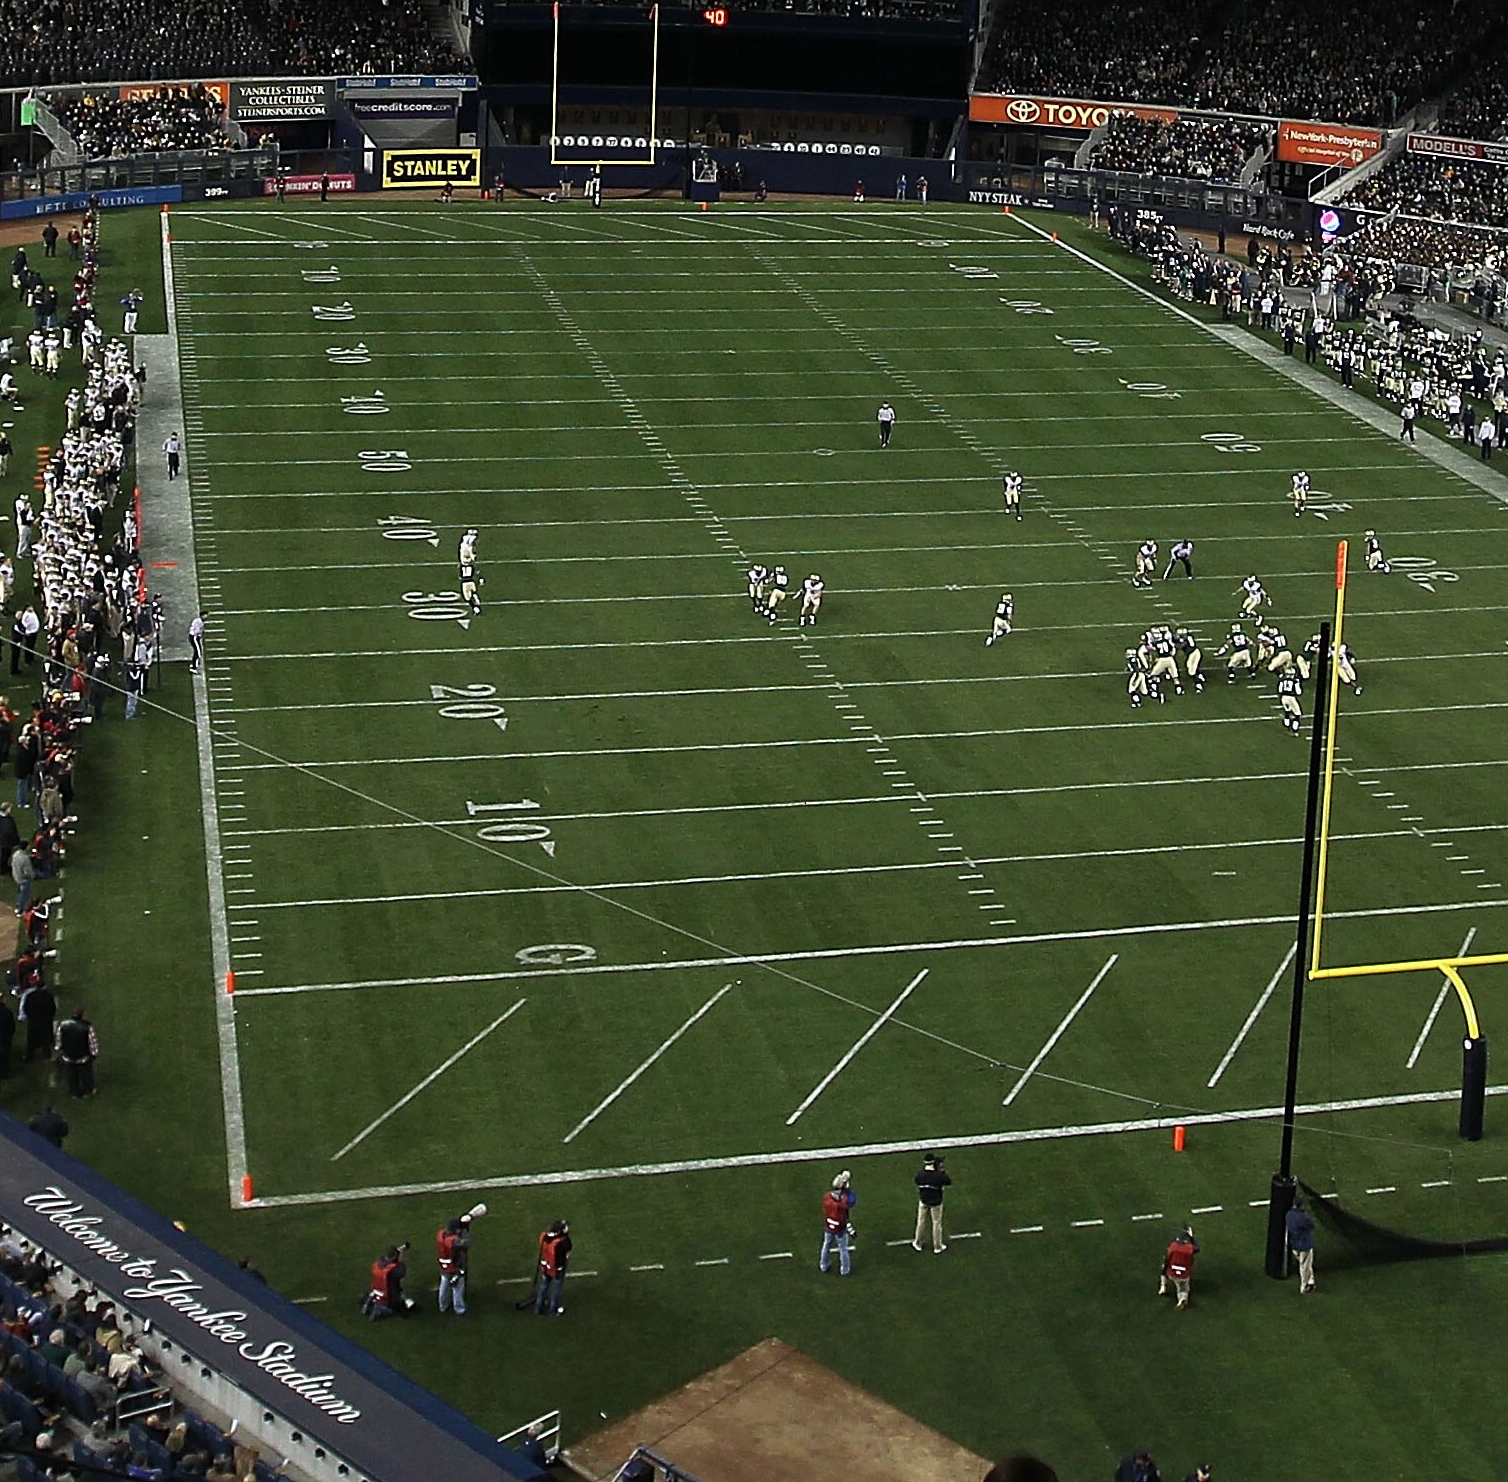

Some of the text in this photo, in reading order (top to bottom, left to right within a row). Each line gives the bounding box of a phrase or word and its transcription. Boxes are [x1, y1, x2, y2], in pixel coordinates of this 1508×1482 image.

[705, 9, 726, 26] 40
[249, 94, 315, 106] COLLECTIBLES
[355, 103, 452, 112] freecreditscore.com
[238, 106, 325, 117] STEINERSPORTS.COM
[1044, 104, 1135, 126] TOYO
[1412, 138, 1477, 157] MODELL'S
[393, 159, 470, 177] STANLEY
[969, 191, 991, 203] NYY
[992, 193, 1023, 206] STEAK
[1243, 223, 1277, 238] Hard Rock
[466, 798, 551, 842] 10
[23, 1186, 362, 1424] Welcome to Yankee Stadium
